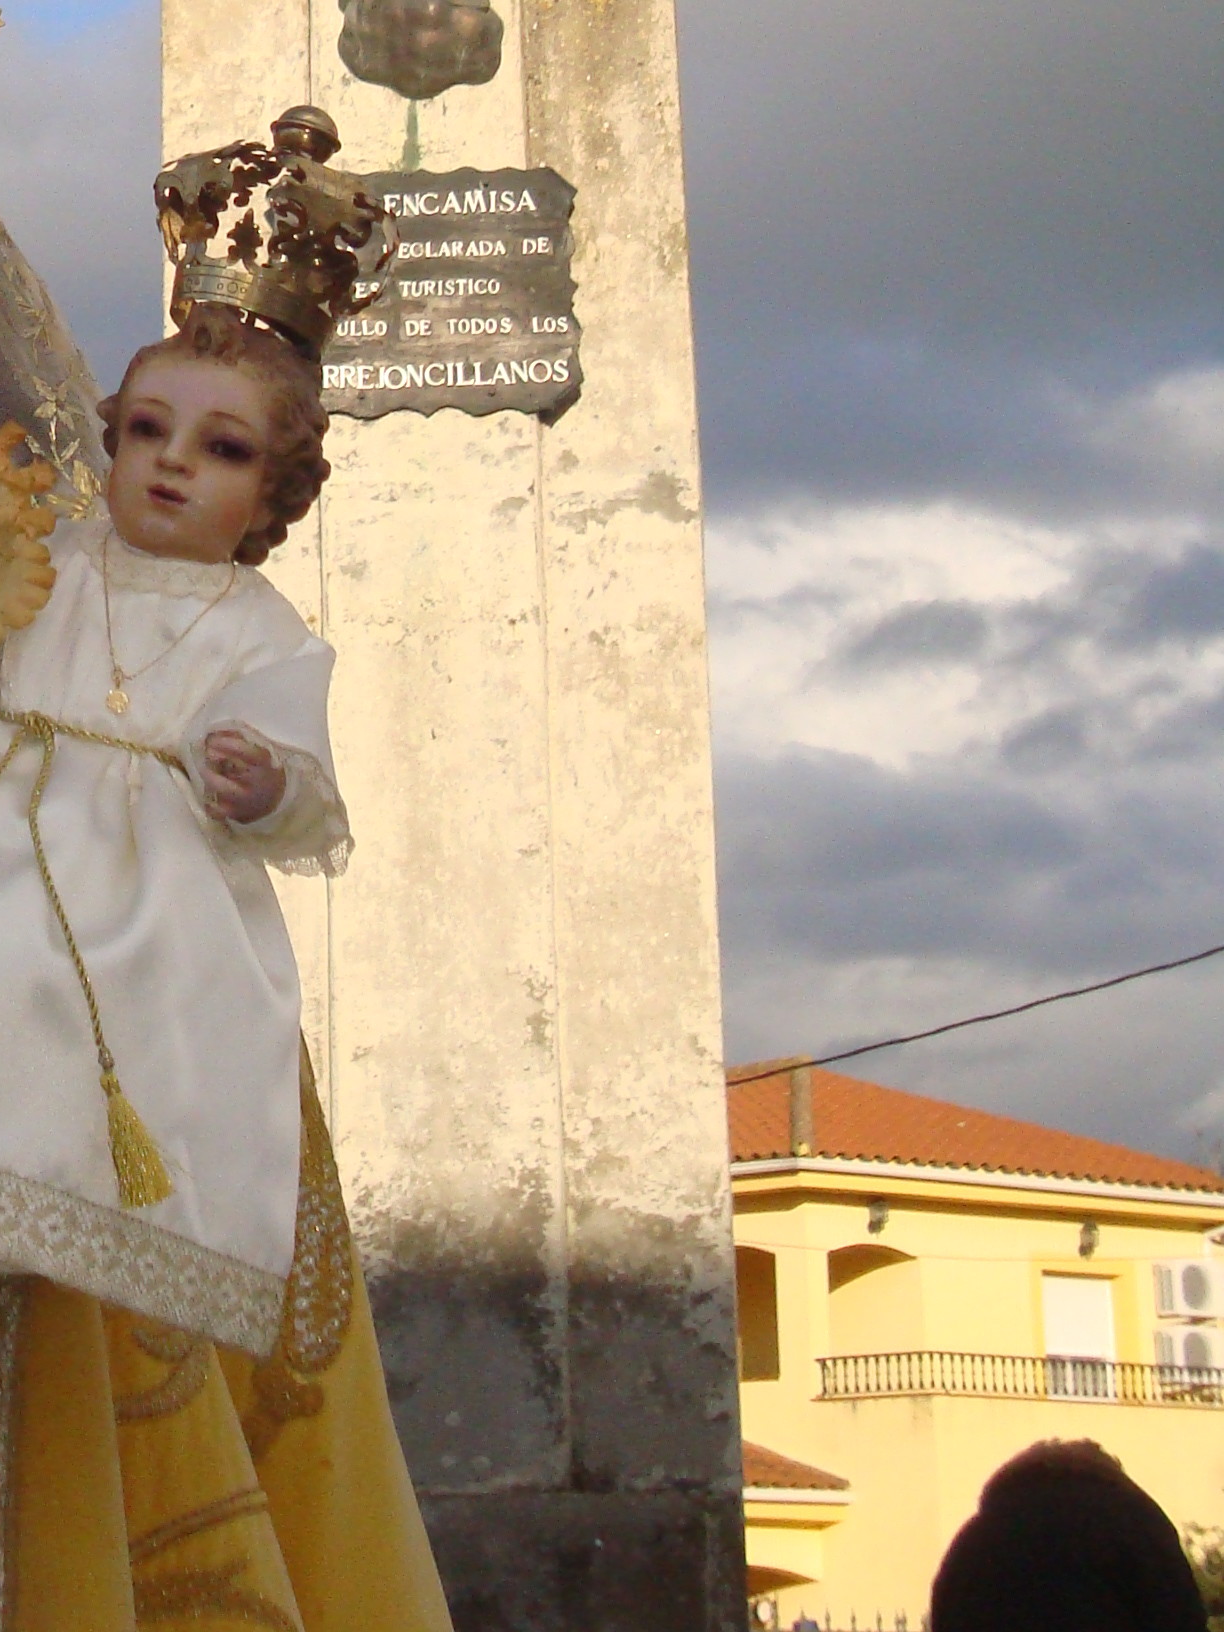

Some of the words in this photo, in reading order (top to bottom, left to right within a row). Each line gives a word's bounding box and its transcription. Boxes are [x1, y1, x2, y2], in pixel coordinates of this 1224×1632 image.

[382, 189, 538, 217] ENCAMISA
[382, 240, 507, 259] ECLARADA
[522, 237, 551, 256] DE
[354, 282, 381, 298] ES
[399, 278, 501, 298] TURISTICO
[336, 319, 389, 337] ULLO
[405, 319, 433, 337] DE
[446, 317, 514, 335] TODOS
[532, 316, 569, 334] LOS
[322, 358, 570, 390] RREJONCILLANOS
